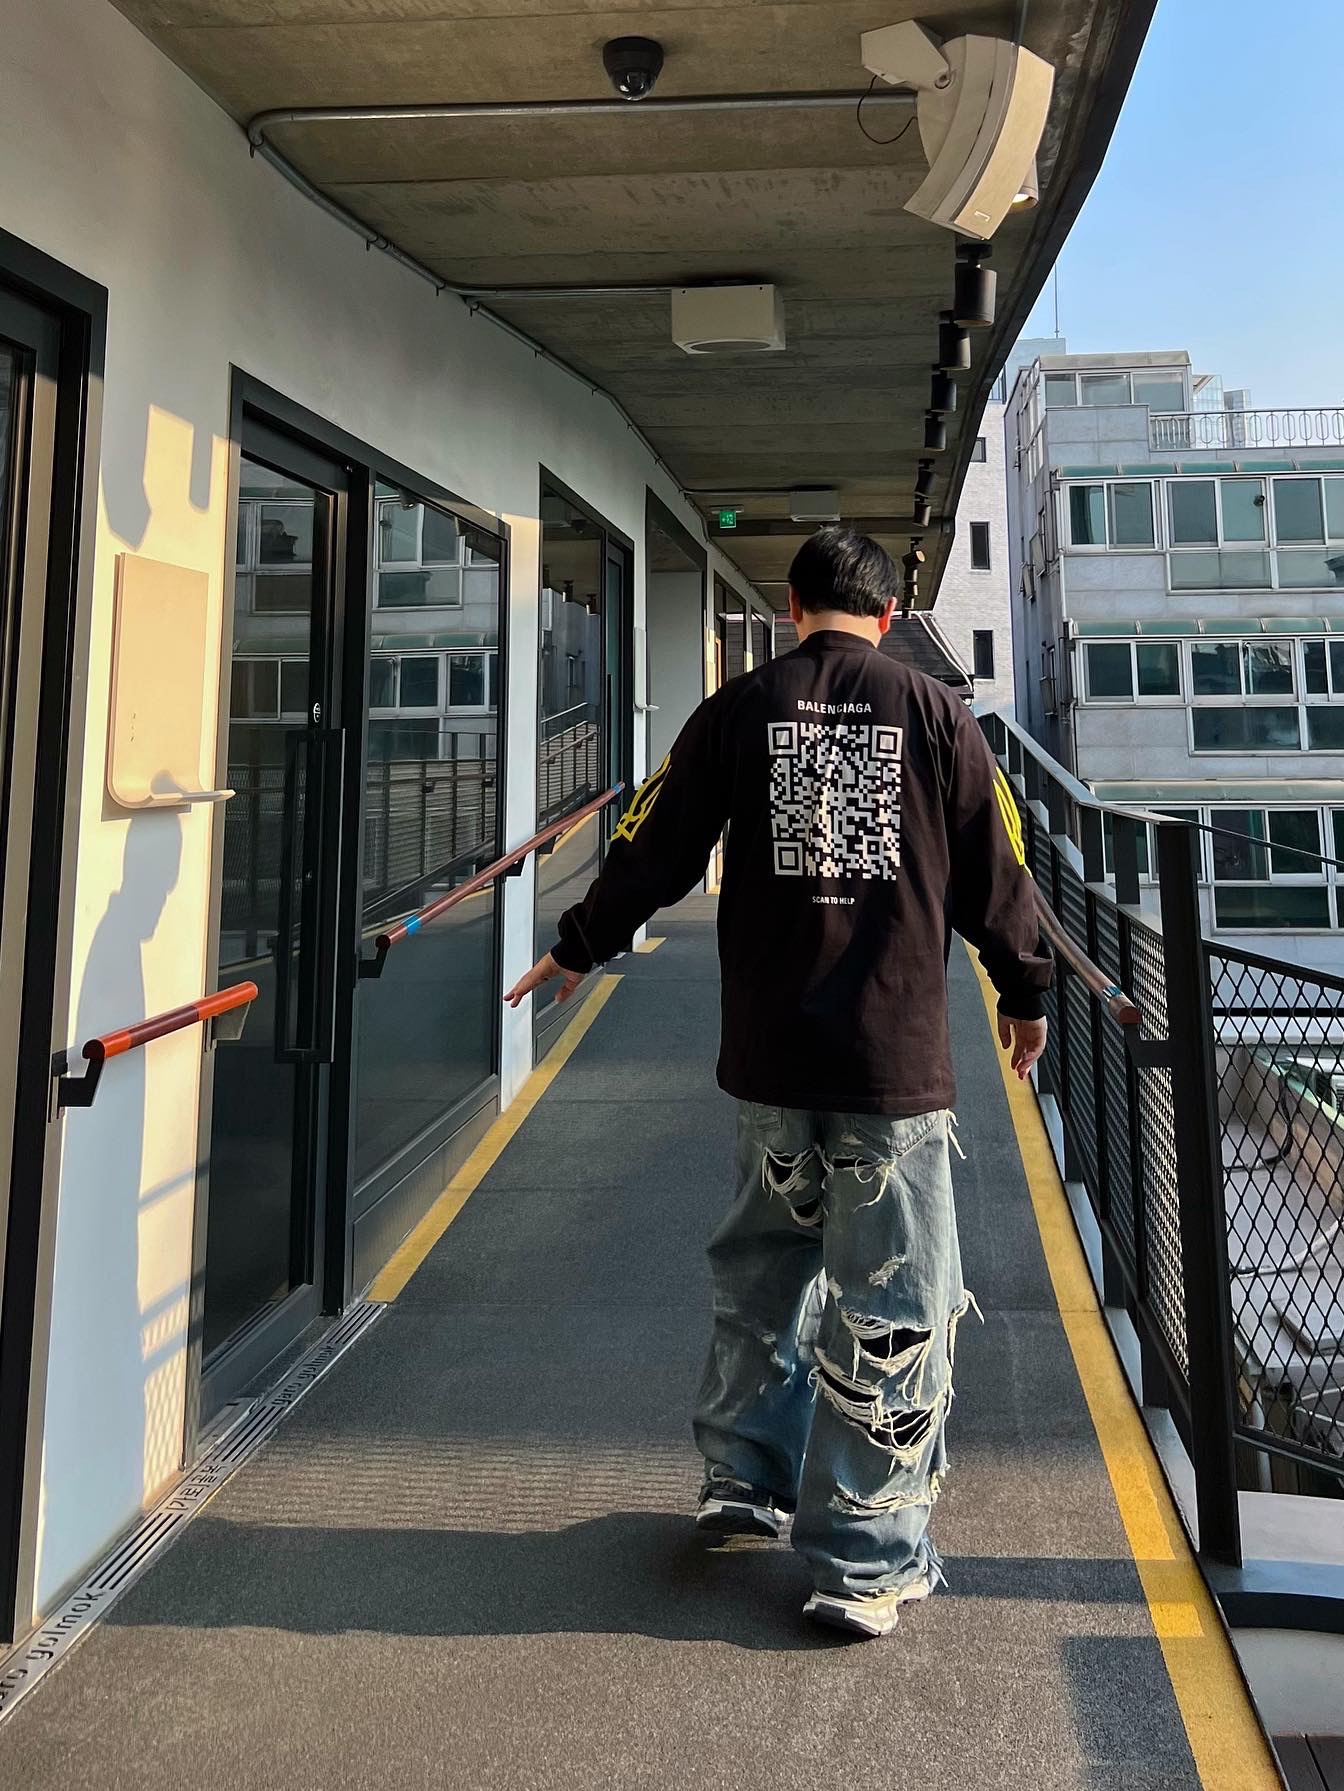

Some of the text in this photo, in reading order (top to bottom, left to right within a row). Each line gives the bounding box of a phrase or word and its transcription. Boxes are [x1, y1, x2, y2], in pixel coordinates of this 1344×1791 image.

[797, 699, 872, 714] BALENCIAGA
[812, 895, 856, 905] SCAN TO HELP
[25, 1591, 105, 1660] golmok
